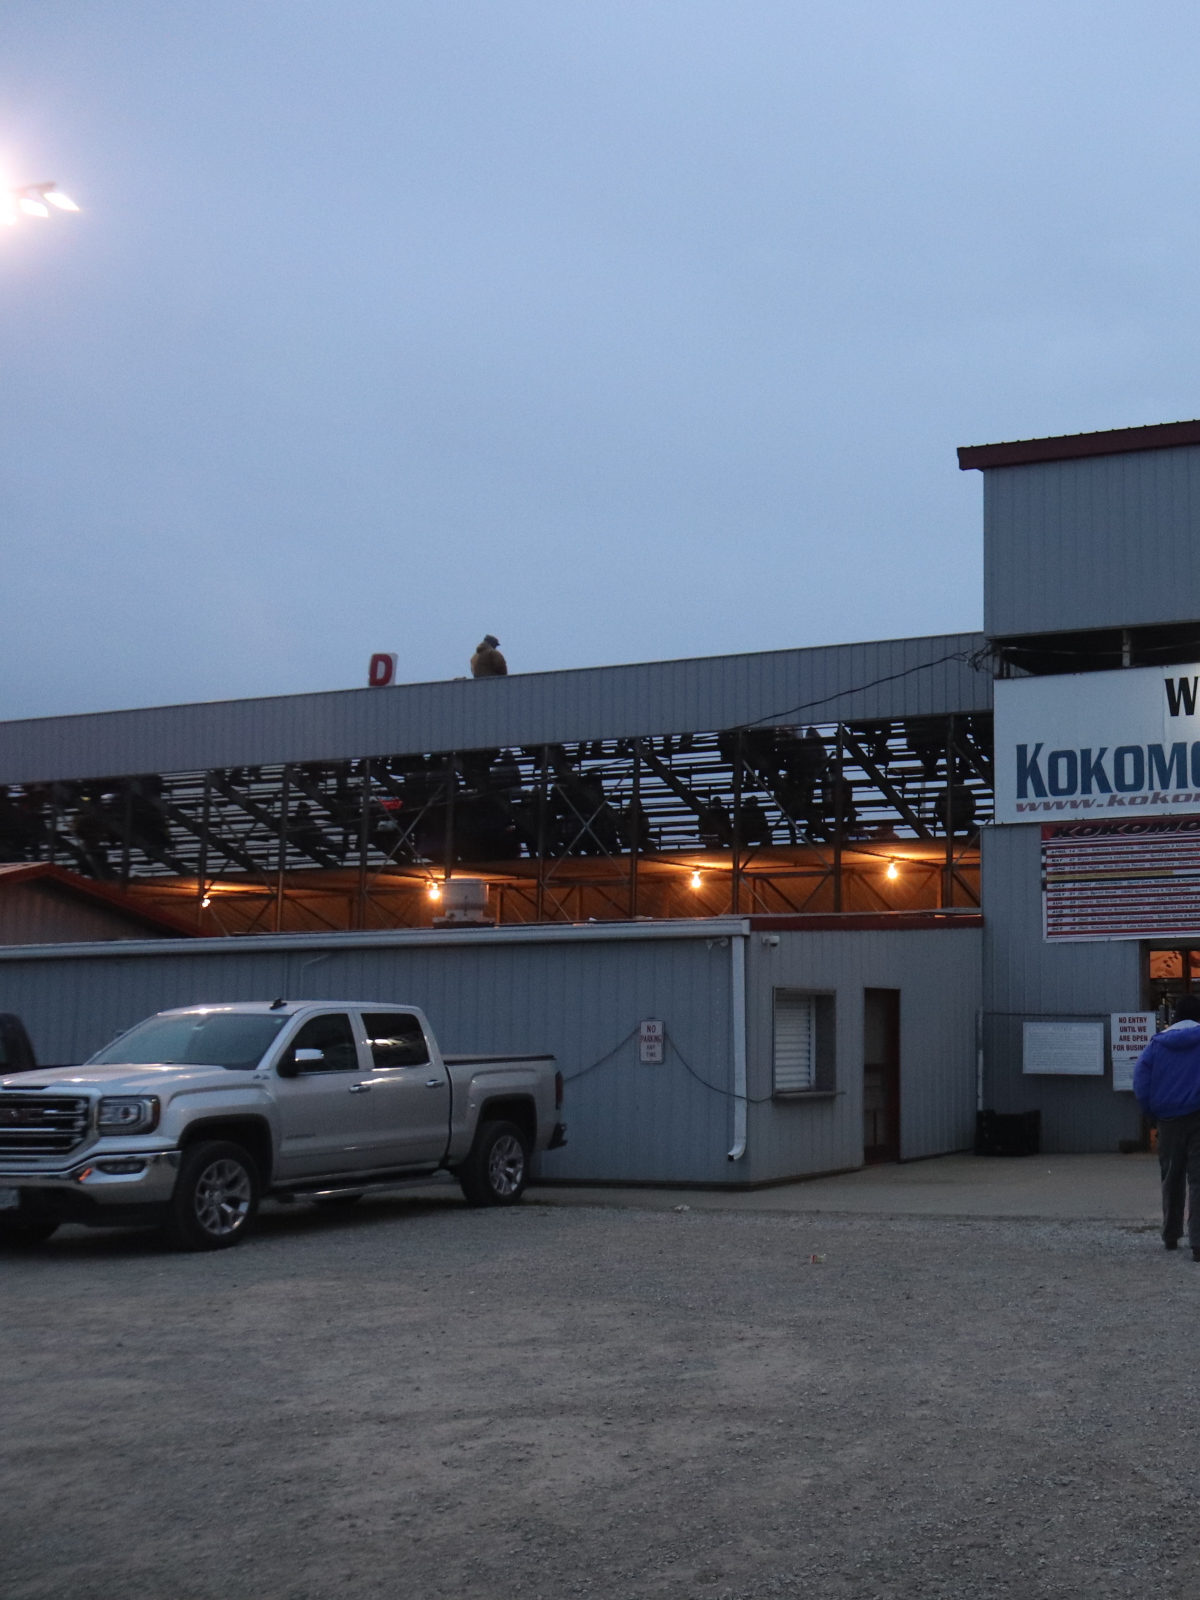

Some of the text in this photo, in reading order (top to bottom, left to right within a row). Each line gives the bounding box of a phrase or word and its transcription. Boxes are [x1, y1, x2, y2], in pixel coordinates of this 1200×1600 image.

[369, 654, 393, 687] D
[646, 1025, 656, 1033] NO
[640, 1034, 662, 1043] PARKING
